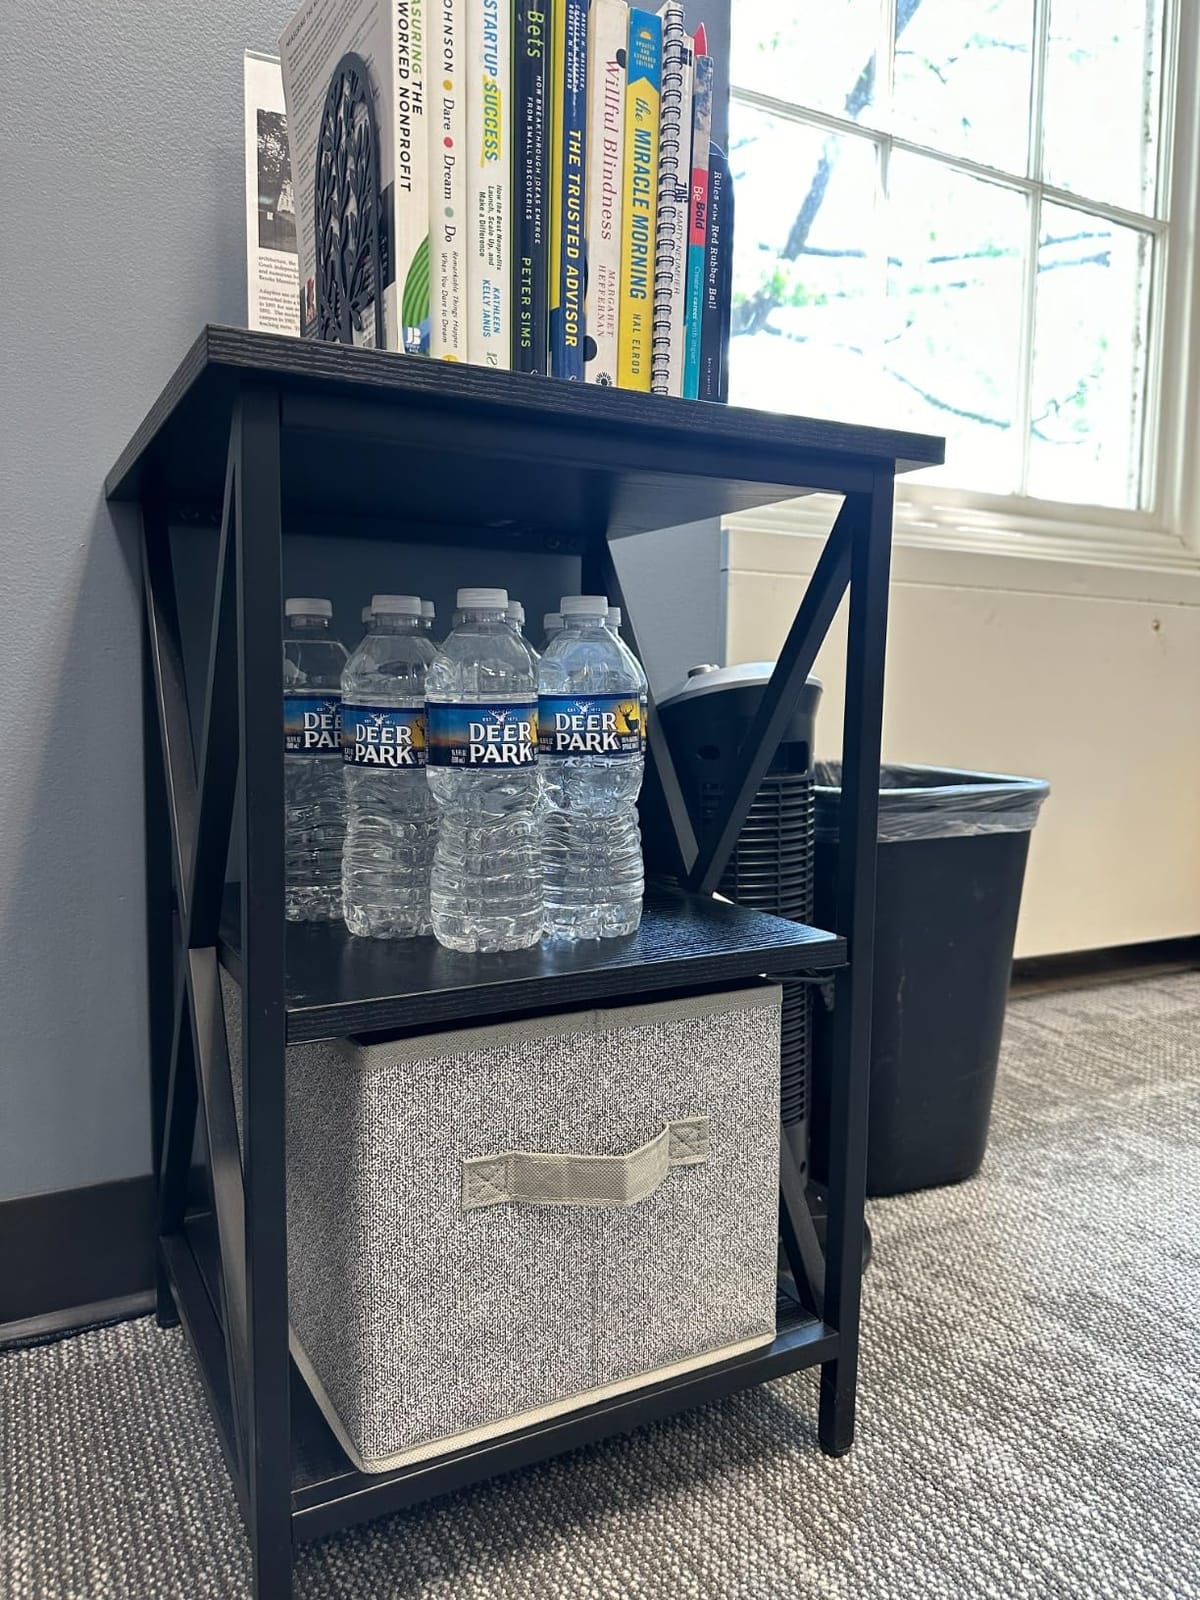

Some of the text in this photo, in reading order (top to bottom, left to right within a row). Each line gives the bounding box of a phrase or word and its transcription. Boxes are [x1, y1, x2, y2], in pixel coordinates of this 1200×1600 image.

[527, 10, 545, 58] Bets
[398, 2, 411, 191] WORKED NONPROFIT
[412, 81, 422, 115] THE
[484, 0, 498, 161] STARTUP SUCCESS
[443, 98, 455, 130] Dare
[601, 60, 621, 241] Willful Blindness
[443, 155, 456, 199] Dream
[525, 159, 533, 220] DISCOVERIES
[713, 171, 722, 200] Rules
[629, 97, 652, 300] the MIRACLE MORNING
[693, 184, 706, 229] Be Bold
[444, 225, 457, 243] Do
[478, 220, 486, 257] Difference
[534, 207, 542, 244] EMERGE
[565, 130, 581, 347] THE TRUSTED ADVISOR
[711, 224, 720, 244] Red
[674, 209, 684, 295] MARTY NEUMEIER
[708, 247, 719, 284] Rubber
[441, 273, 449, 287] You
[441, 290, 449, 307] Dare
[708, 286, 718, 310] Ball
[450, 251, 459, 349] Remarkable Things Happen
[482, 279, 491, 338] KELLY JANUS
[493, 287, 502, 334] KATHLEEN
[520, 257, 532, 348] PETER SIMS
[597, 265, 607, 337] HEFFERNAN
[608, 270, 616, 338] MARGARET
[441, 319, 449, 343] Dream
[631, 313, 642, 375] HAL ELROD
[304, 712, 343, 730] DEE
[304, 730, 343, 748] PAR
[356, 724, 412, 745] DEER
[469, 721, 532, 742] DEER
[555, 712, 617, 731] DEER
[355, 744, 414, 767] PARK
[469, 743, 533, 765] PARK
[556, 732, 619, 753] PARK
